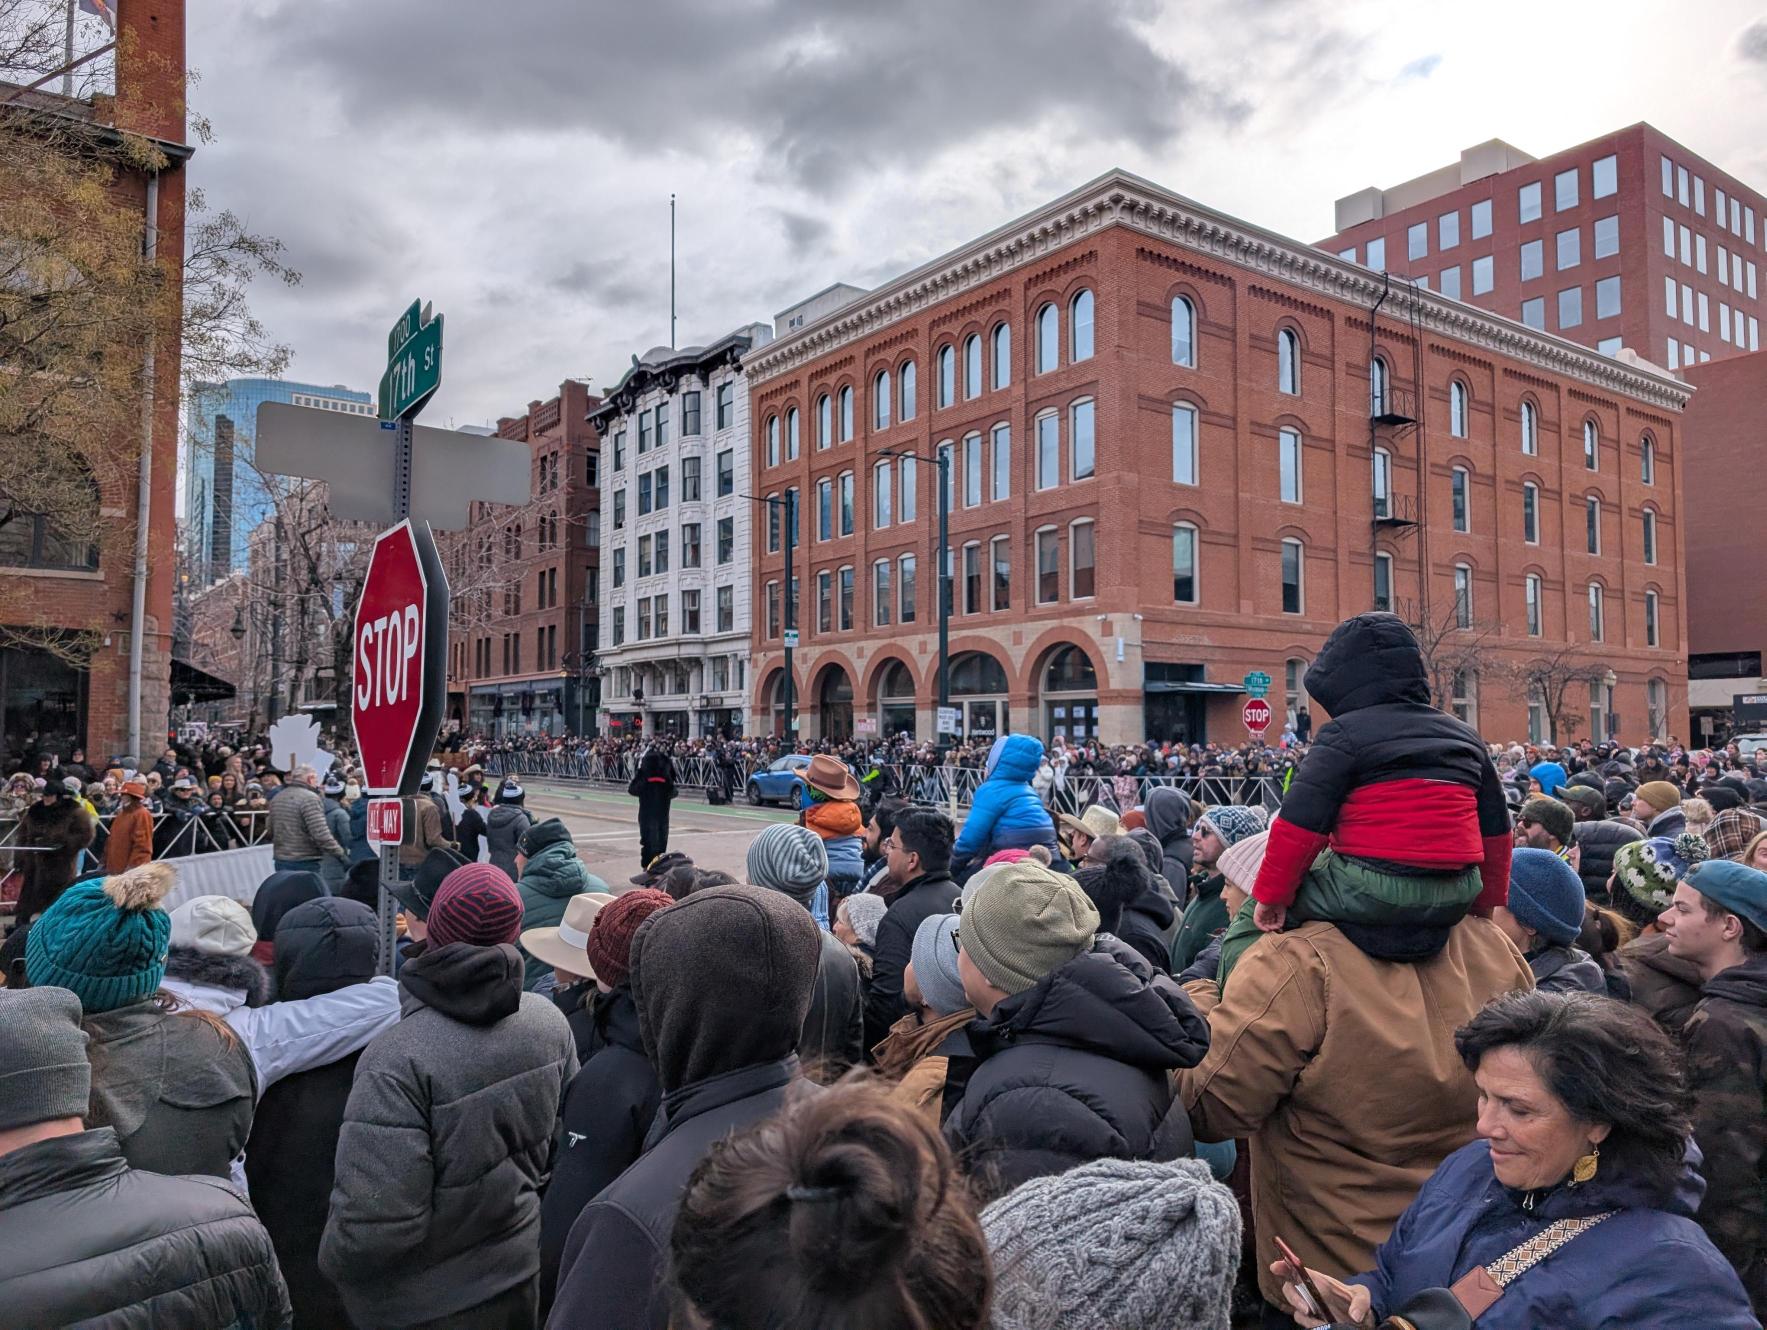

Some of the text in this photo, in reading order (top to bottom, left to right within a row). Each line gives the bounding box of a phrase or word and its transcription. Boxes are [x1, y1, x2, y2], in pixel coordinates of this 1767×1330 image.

[393, 314, 411, 353] 1700
[388, 343, 435, 419] 17th St
[357, 603, 420, 712] STOP
[1245, 708, 1269, 722] STOP
[369, 808, 399, 834] ALL WAY
